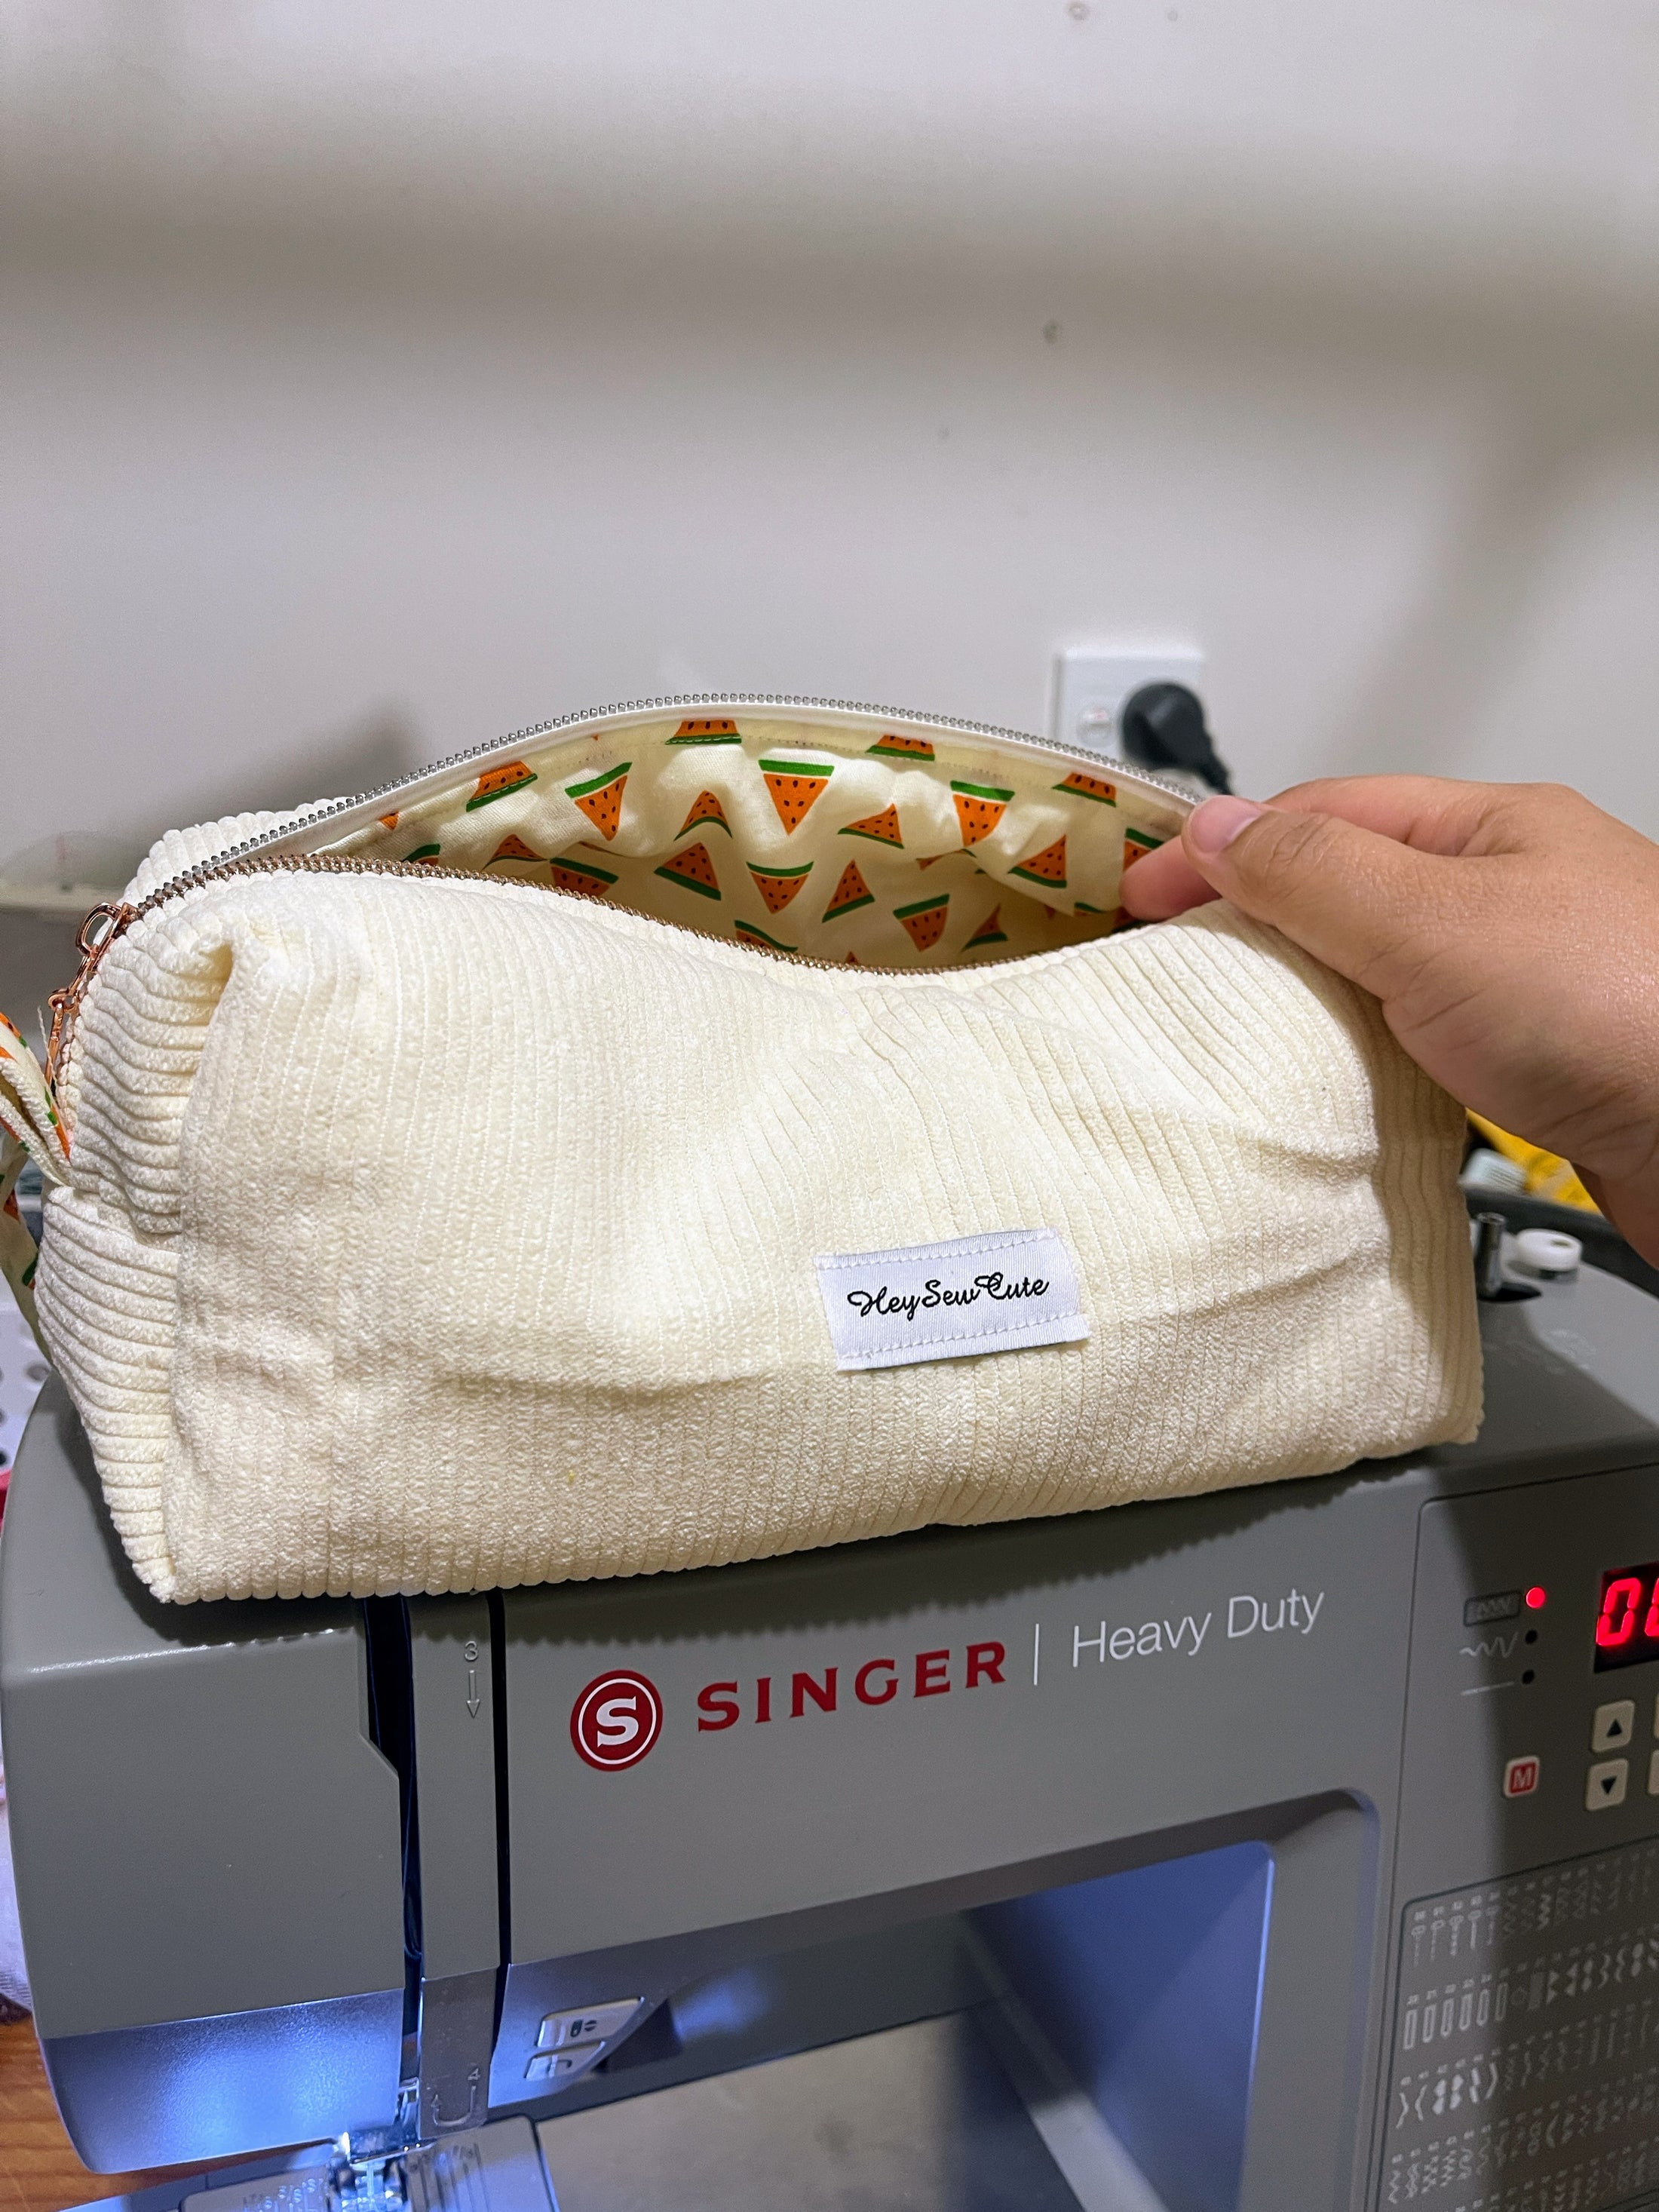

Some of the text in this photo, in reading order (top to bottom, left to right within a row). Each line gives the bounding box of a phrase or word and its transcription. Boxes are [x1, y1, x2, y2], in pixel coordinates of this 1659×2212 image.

[465, 1640, 478, 1661] 3
[596, 1588, 1325, 1748] S SINGER Heavy Duty
